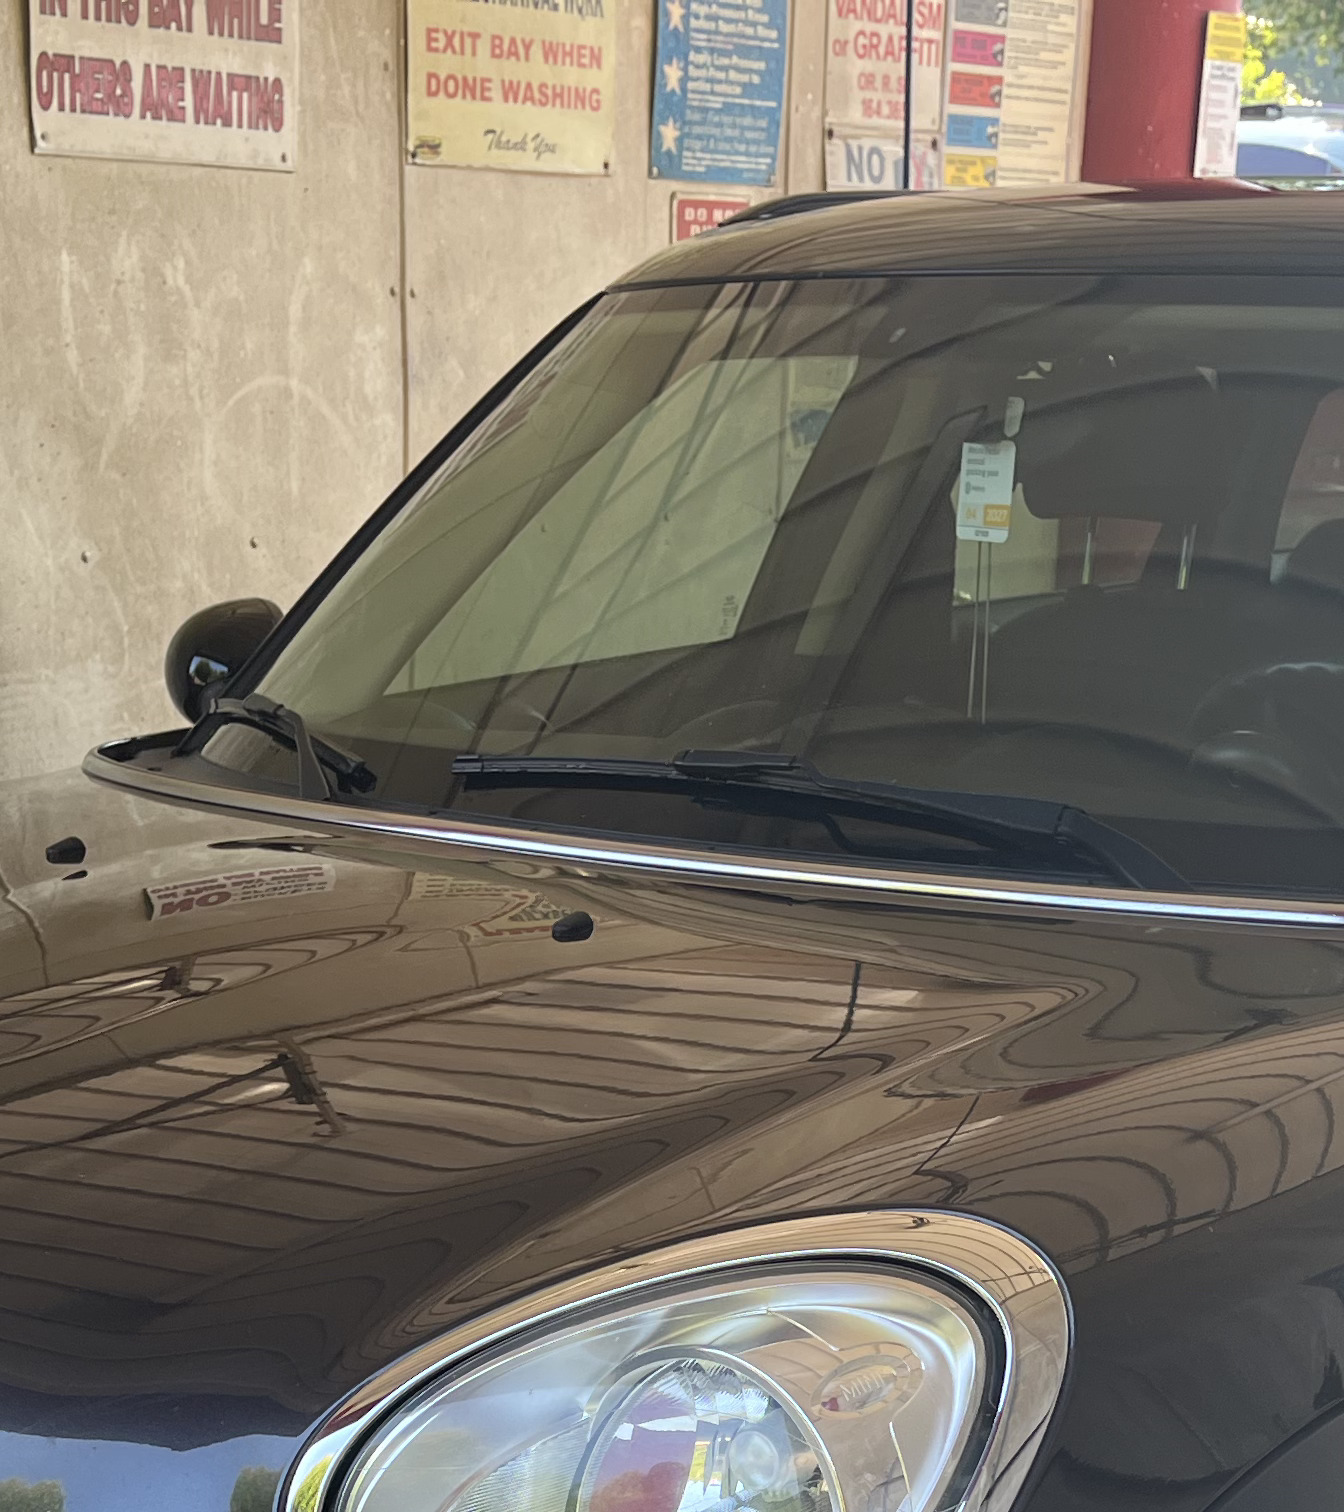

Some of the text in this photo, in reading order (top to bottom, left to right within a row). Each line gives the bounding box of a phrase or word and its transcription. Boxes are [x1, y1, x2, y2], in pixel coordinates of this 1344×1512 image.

[425, 27, 604, 70] EXIT BAY WHEN
[832, 39, 849, 57] or
[36, 51, 284, 133] OTHERS ARE WAITING
[425, 71, 602, 112] DONE WASHING
[483, 129, 558, 160] Thank You
[845, 142, 886, 185] NO
[684, 207, 707, 222] DO
